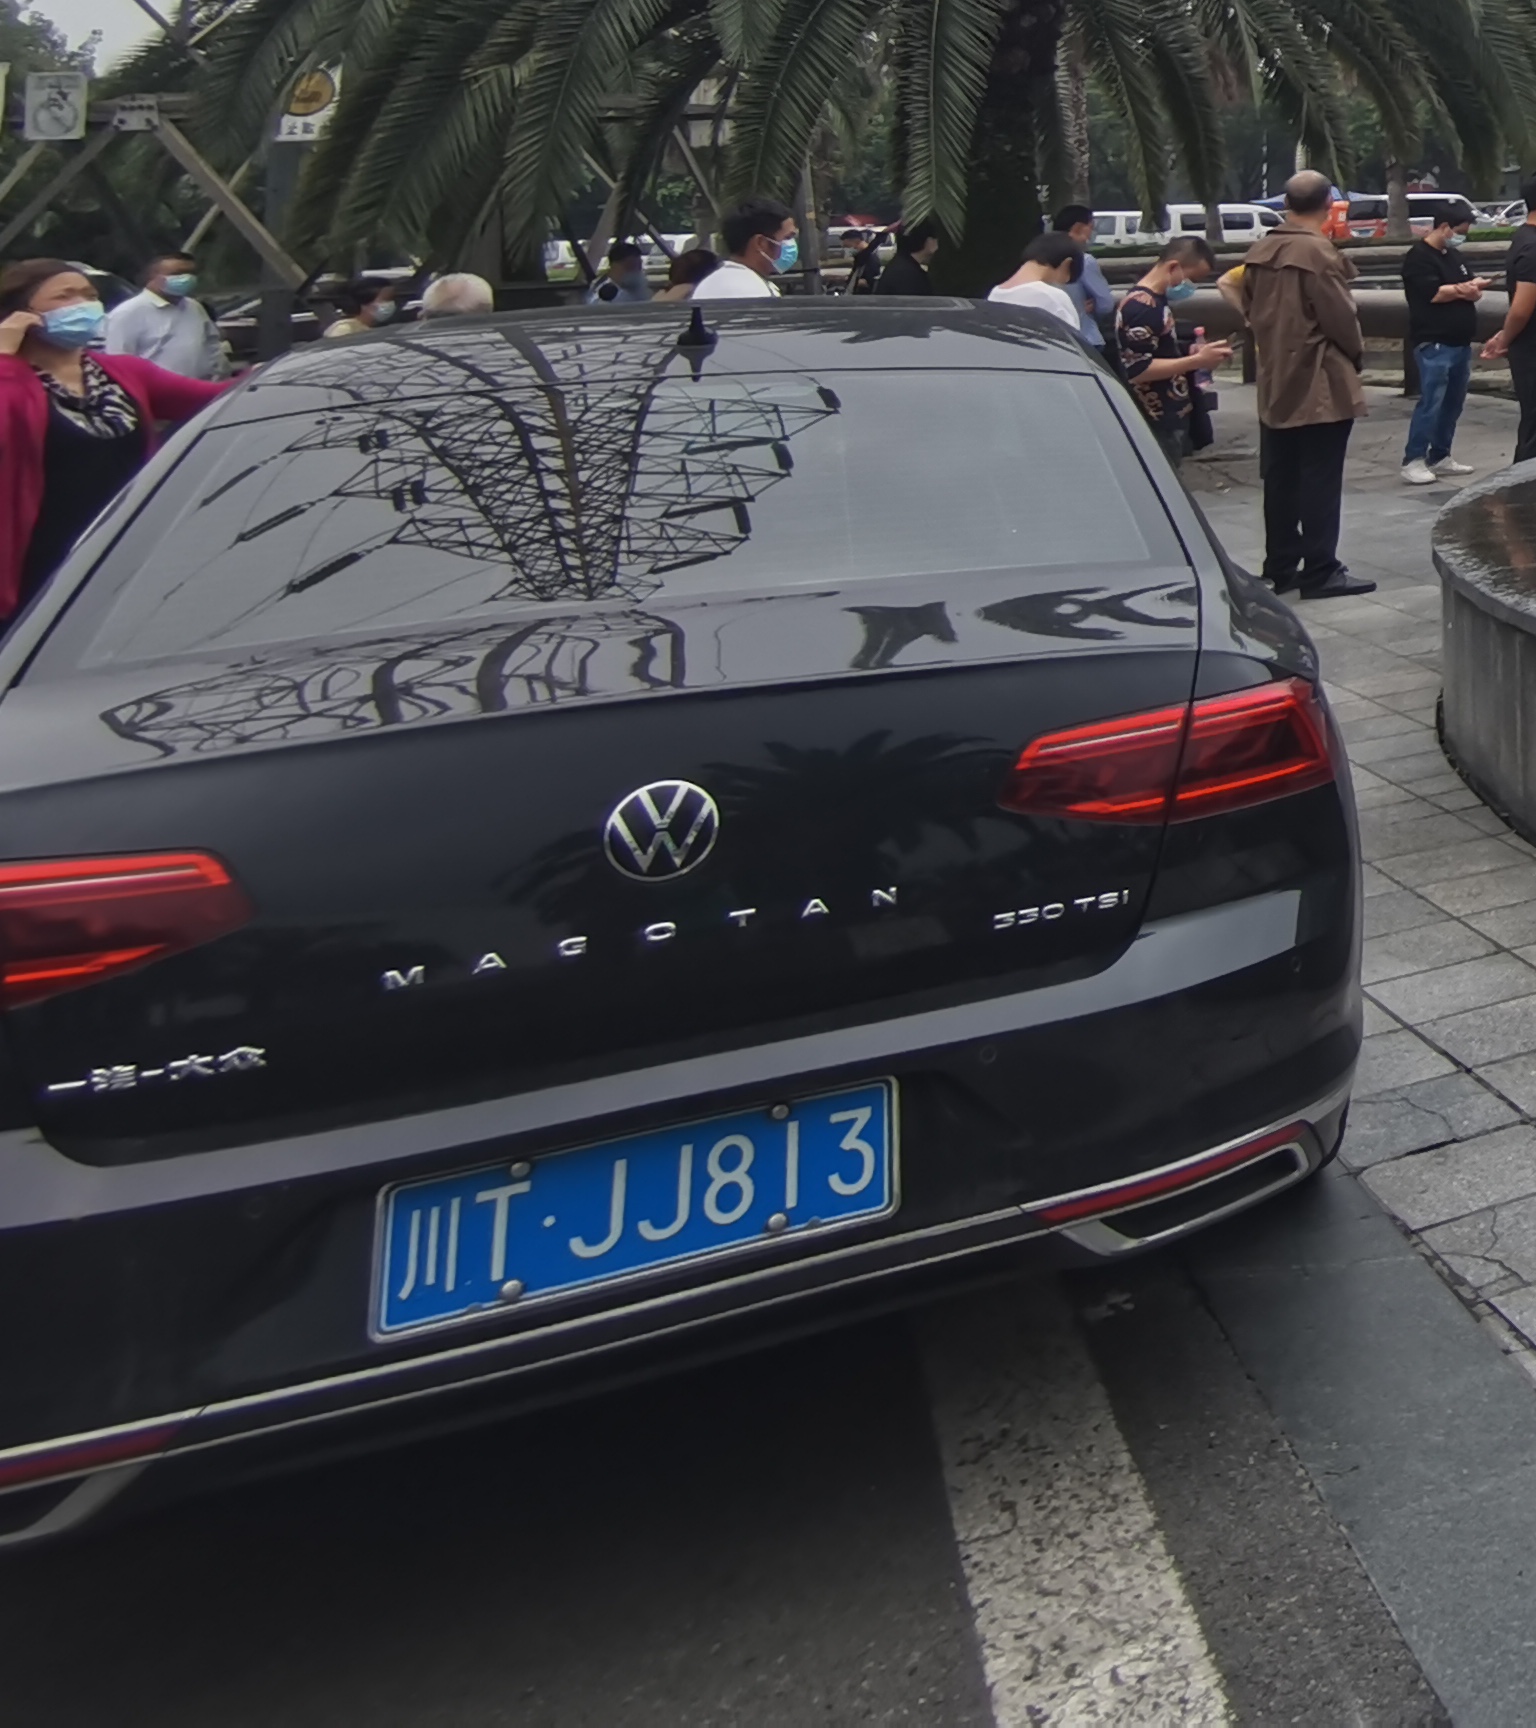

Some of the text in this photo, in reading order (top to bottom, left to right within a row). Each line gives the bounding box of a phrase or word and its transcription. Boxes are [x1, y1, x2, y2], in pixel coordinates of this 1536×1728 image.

[382, 885, 898, 991] MAGOTAN
[992, 887, 1130, 932] 330 TSI
